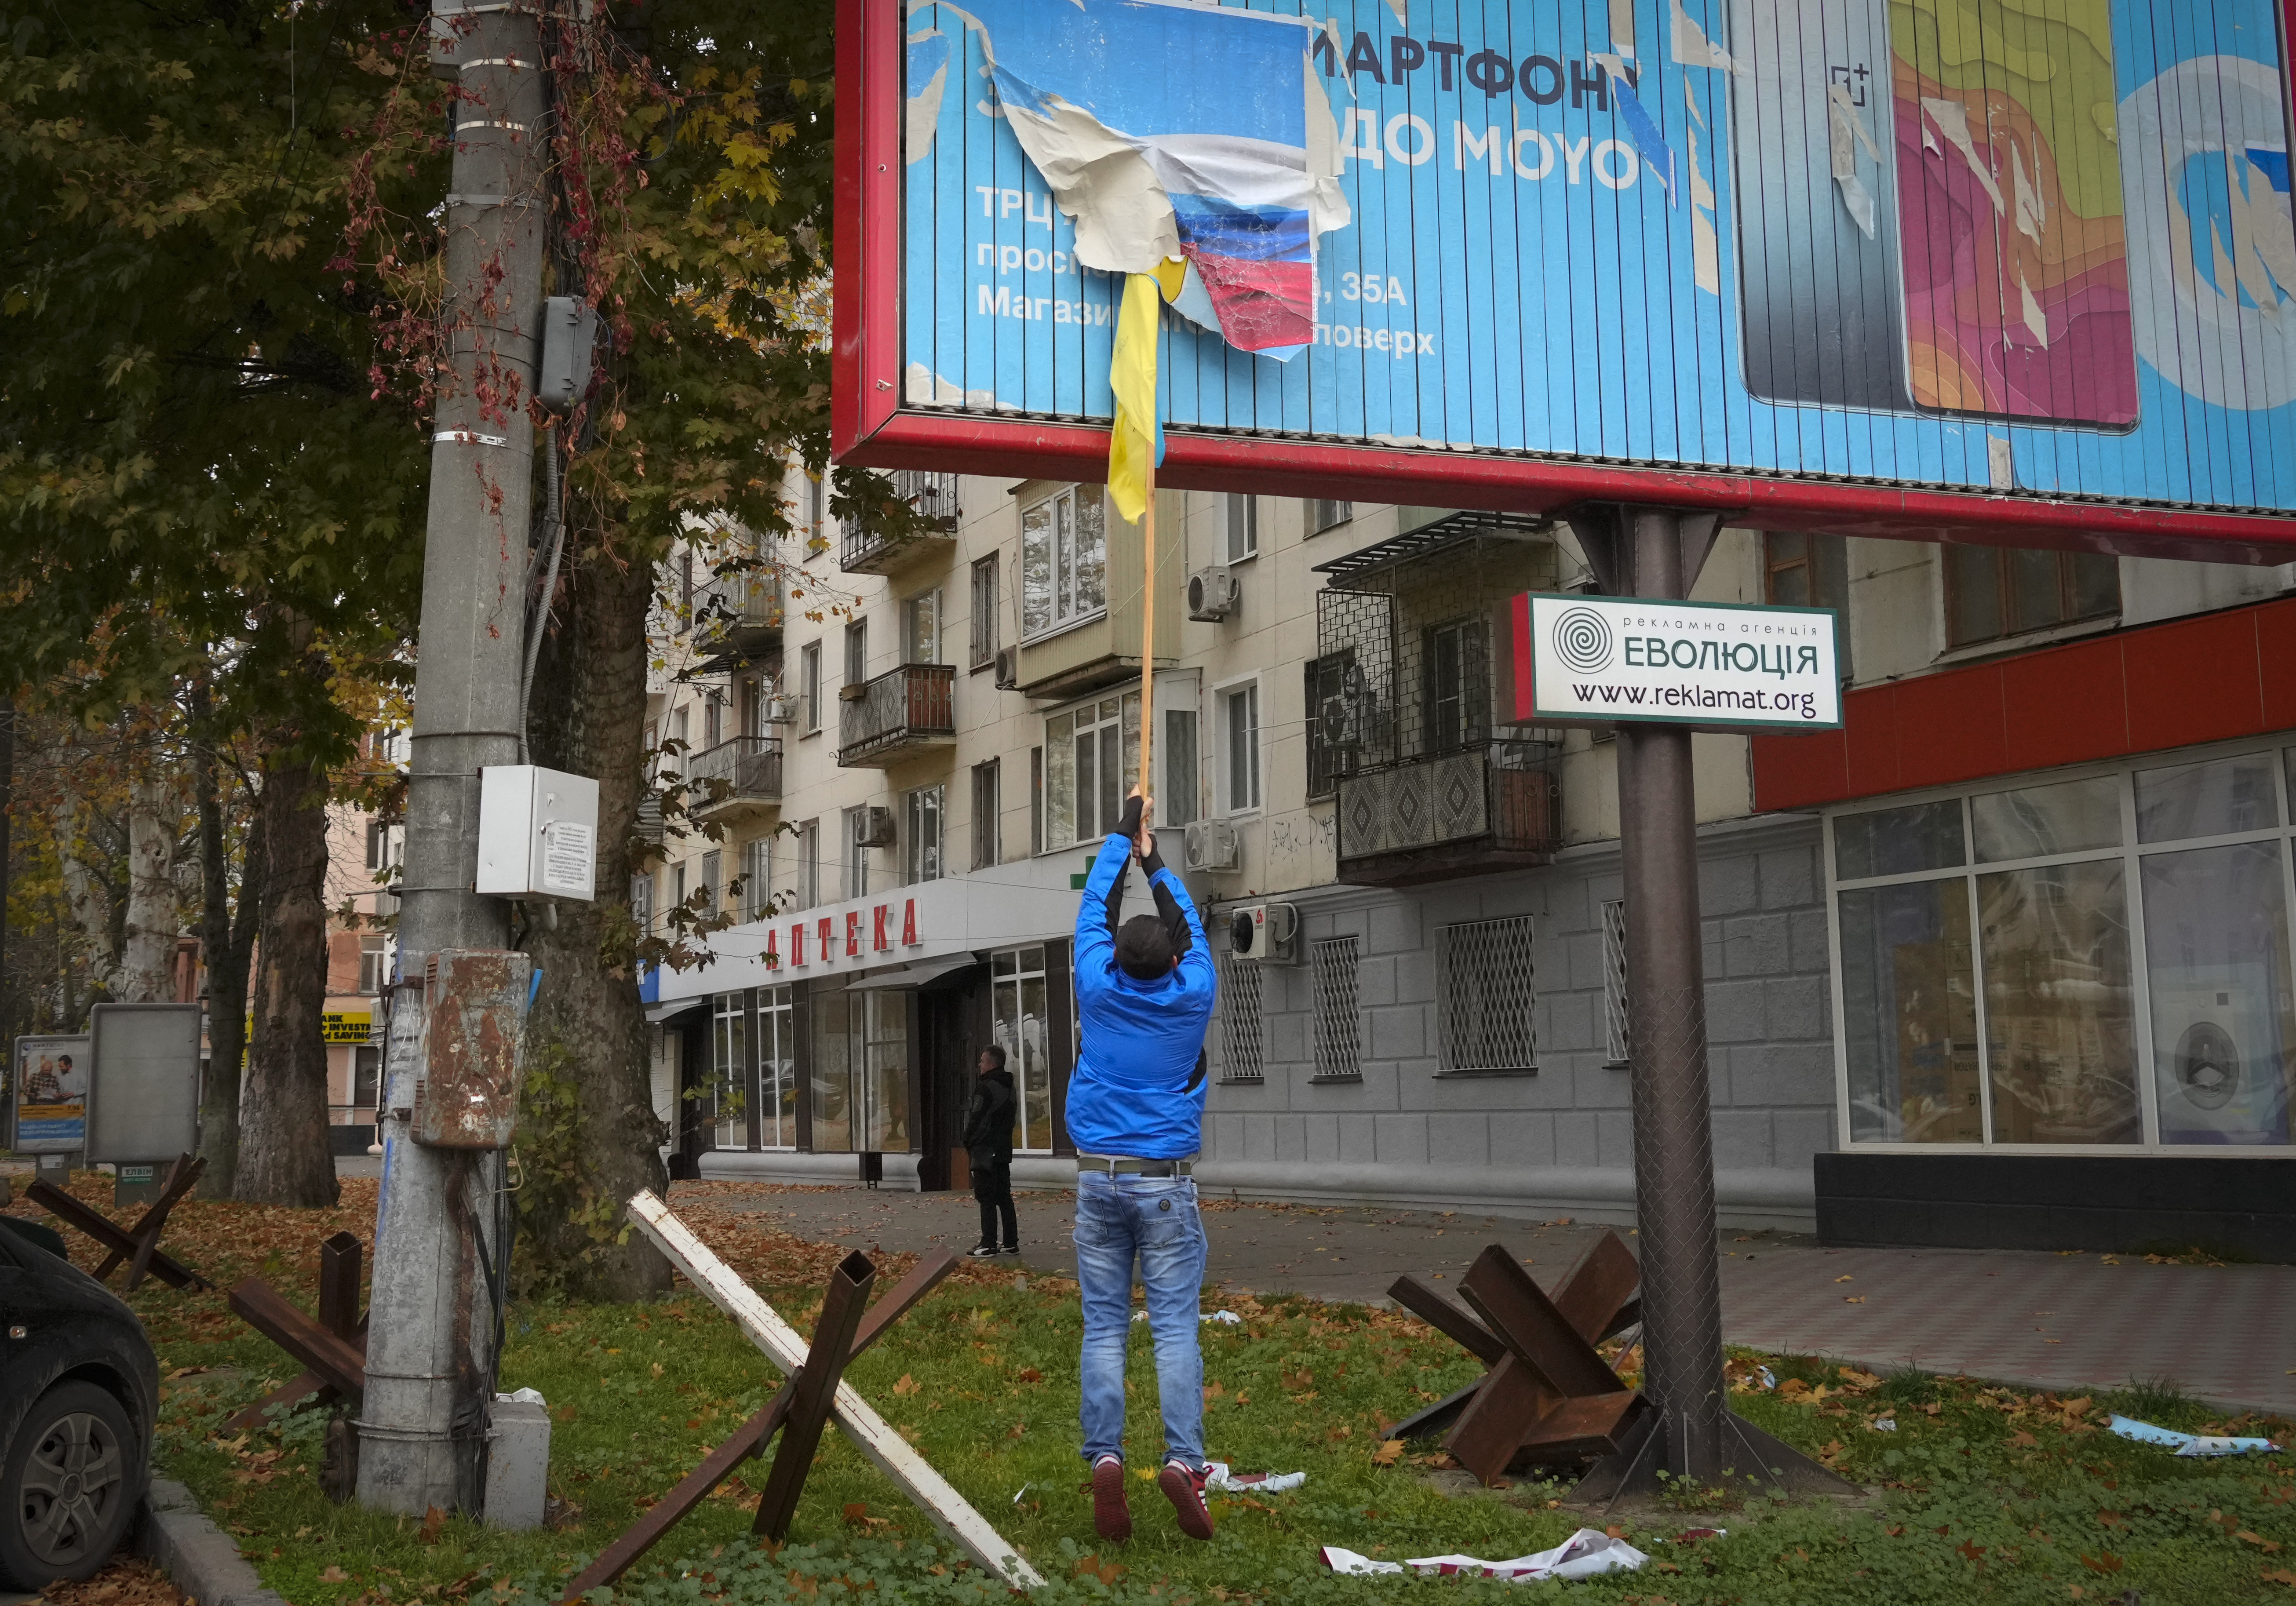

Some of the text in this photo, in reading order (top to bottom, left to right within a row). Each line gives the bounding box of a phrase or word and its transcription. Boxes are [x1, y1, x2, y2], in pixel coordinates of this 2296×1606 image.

[1313, 30, 1636, 112] АРТФОН
[1340, 106, 1435, 169] ДО
[1454, 120, 1639, 190] MOYO
[976, 186, 1053, 231] ТРЦ
[978, 284, 1121, 328] Магази
[1341, 272, 1407, 306] 35А
[1623, 616, 1817, 636] рекламна агенція
[1625, 637, 1819, 680] ЕВОЛЮЦІЯ
[1572, 684, 1816, 719] www.reklamat.org
[766, 898, 922, 971] АПТЕКА
